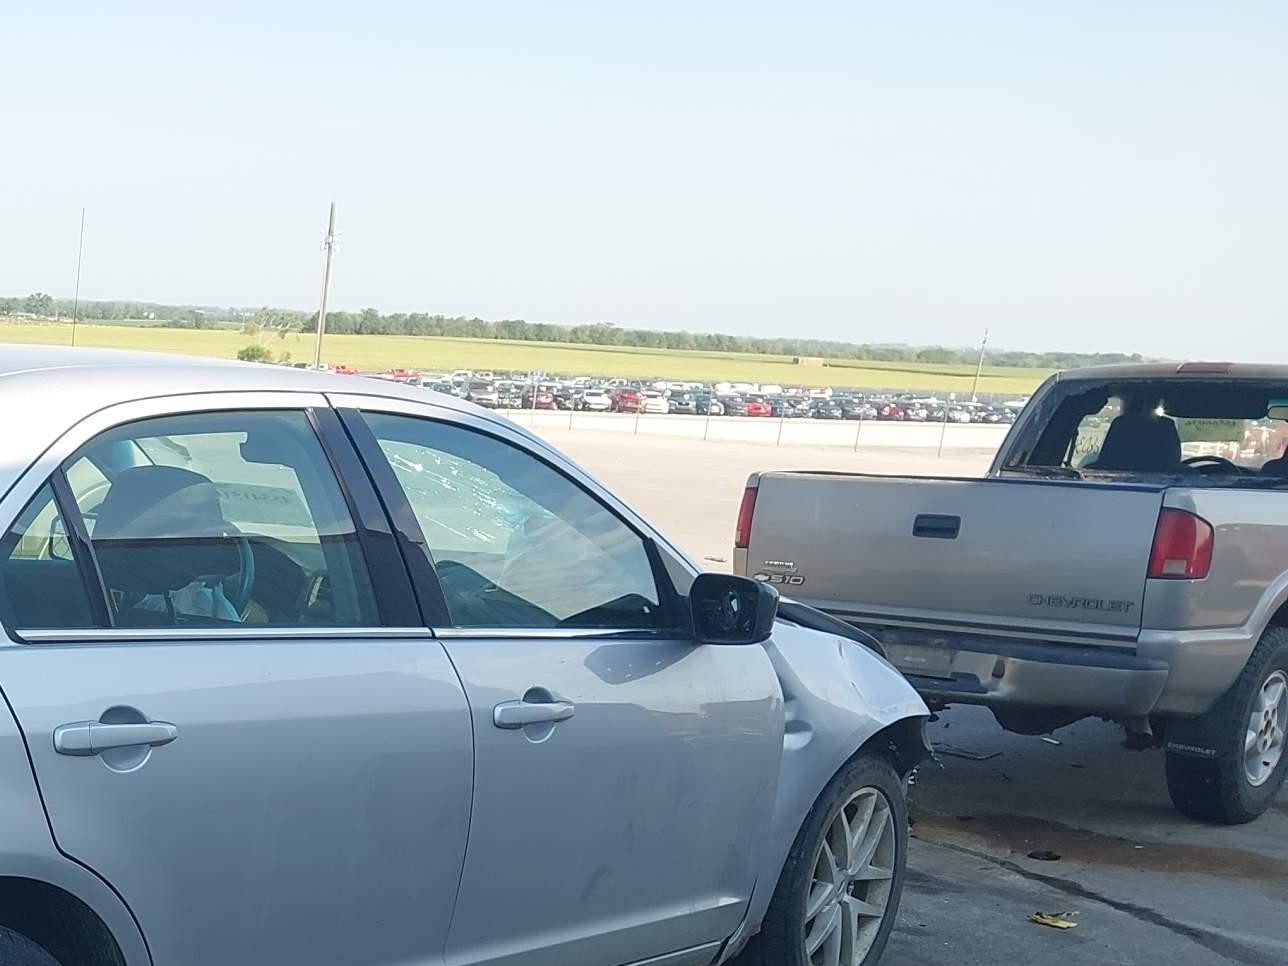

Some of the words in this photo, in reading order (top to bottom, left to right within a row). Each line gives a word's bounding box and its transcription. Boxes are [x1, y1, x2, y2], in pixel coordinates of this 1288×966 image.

[769, 574, 805, 586] S10
[1026, 593, 1135, 613] CHEVROLET
[1167, 742, 1217, 756] CHEVROLET
